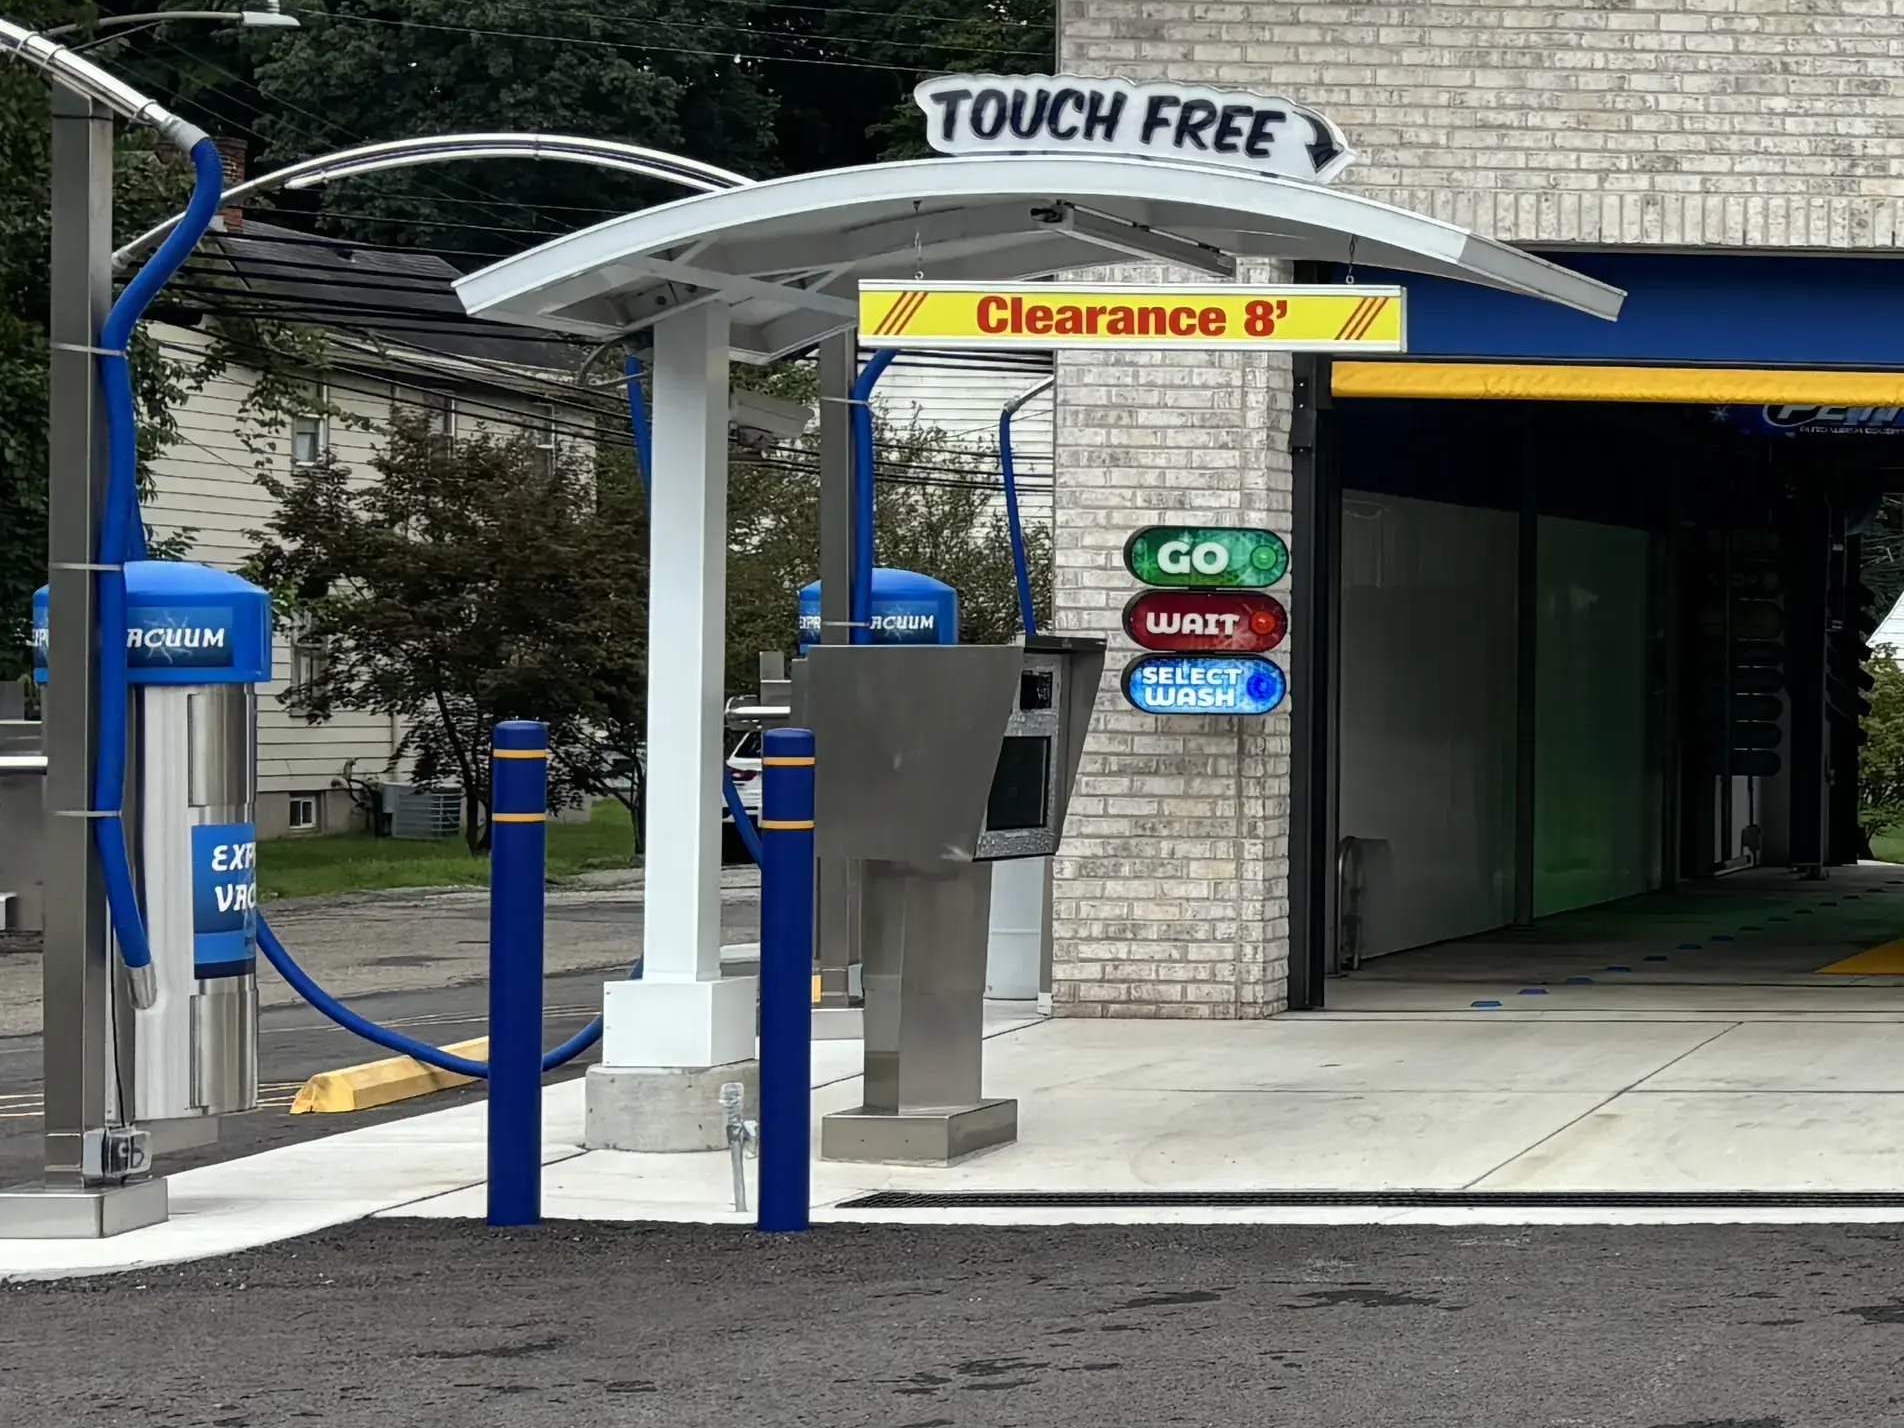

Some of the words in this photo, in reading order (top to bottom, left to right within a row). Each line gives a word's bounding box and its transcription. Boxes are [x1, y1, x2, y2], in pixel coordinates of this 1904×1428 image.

[929, 87, 1128, 142] TOUCH
[1139, 94, 1288, 159] FREE
[976, 295, 1227, 337] Clearance
[1244, 298, 1289, 337] 8'
[1157, 540, 1229, 575] GO
[869, 615, 934, 630] ACUUM
[1146, 612, 1240, 635] WAIT
[126, 628, 225, 648] ACUUM
[1142, 667, 1243, 685] SELECT
[1144, 687, 1235, 707] WASH
